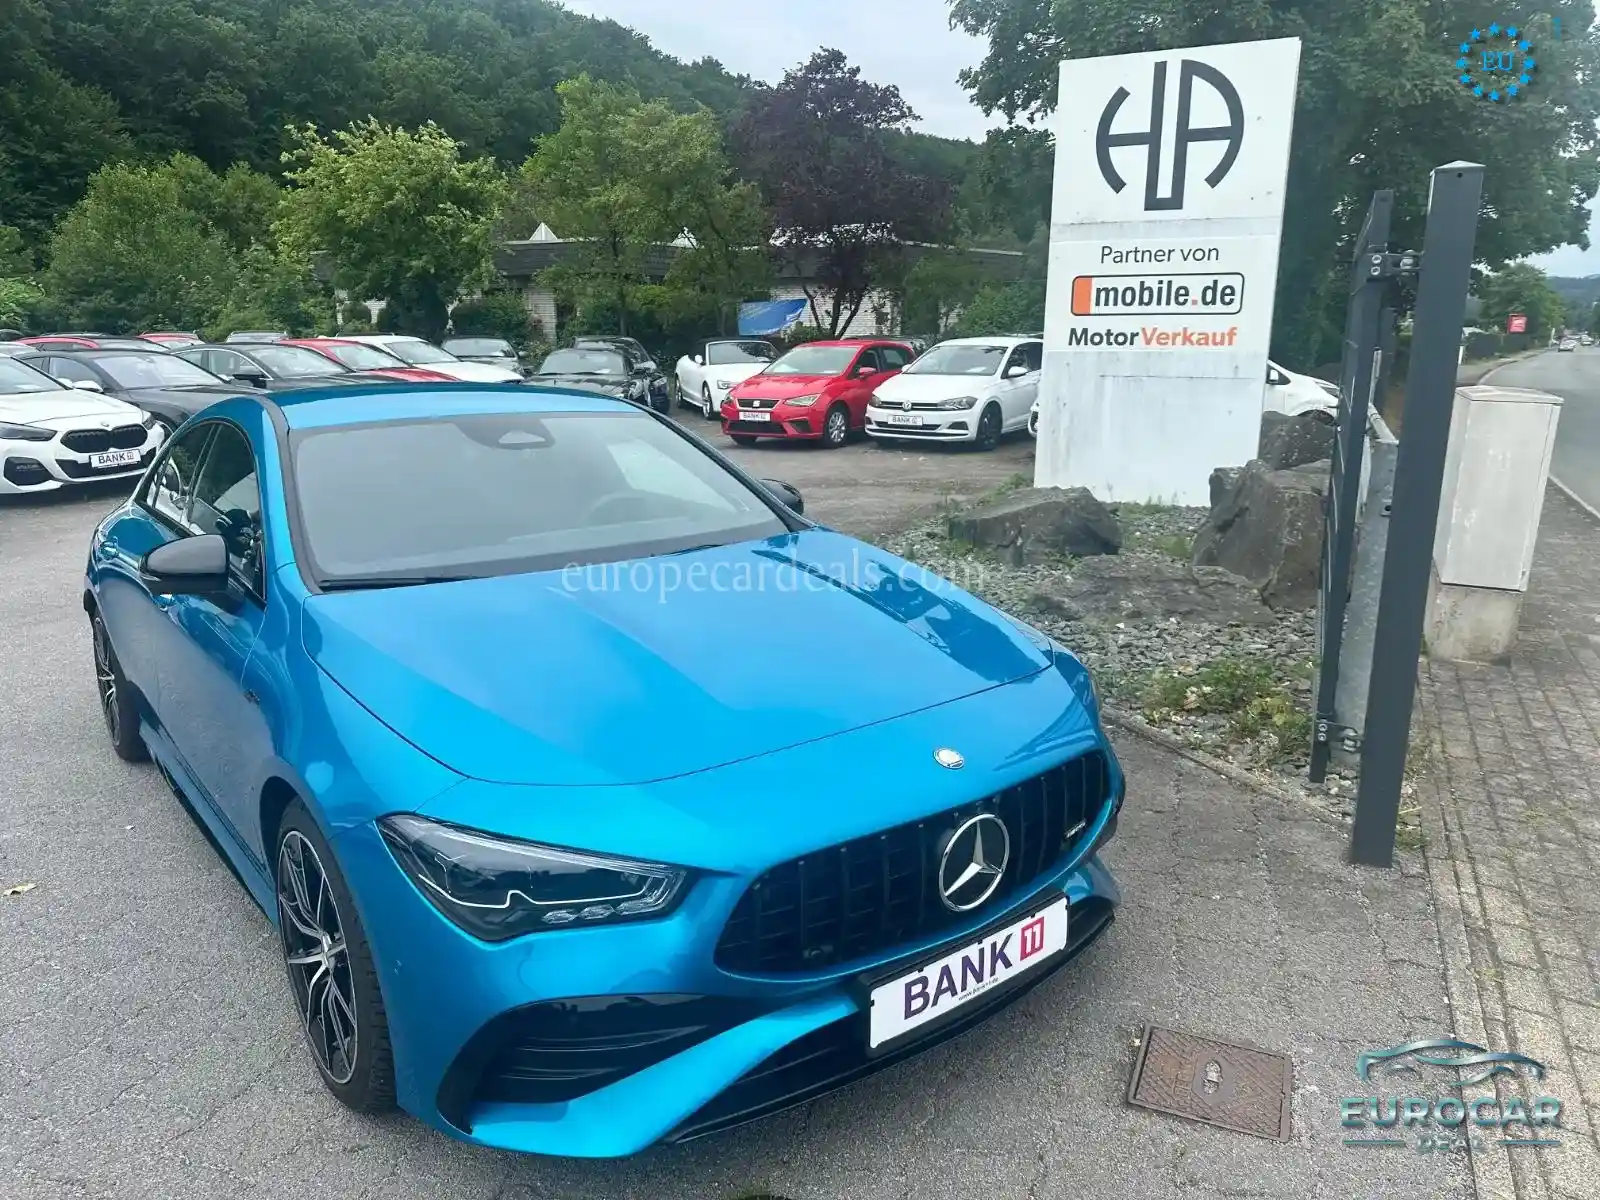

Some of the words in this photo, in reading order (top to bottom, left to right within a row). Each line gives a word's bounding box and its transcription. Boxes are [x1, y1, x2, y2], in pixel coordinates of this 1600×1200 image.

[1100, 245, 1175, 264] Partner
[1180, 247, 1219, 262] von
[1095, 279, 1236, 307] mobile.de
[98, 452, 126, 464] BANK
[904, 932, 1013, 1020] BANK
[1022, 920, 1043, 958] 11
